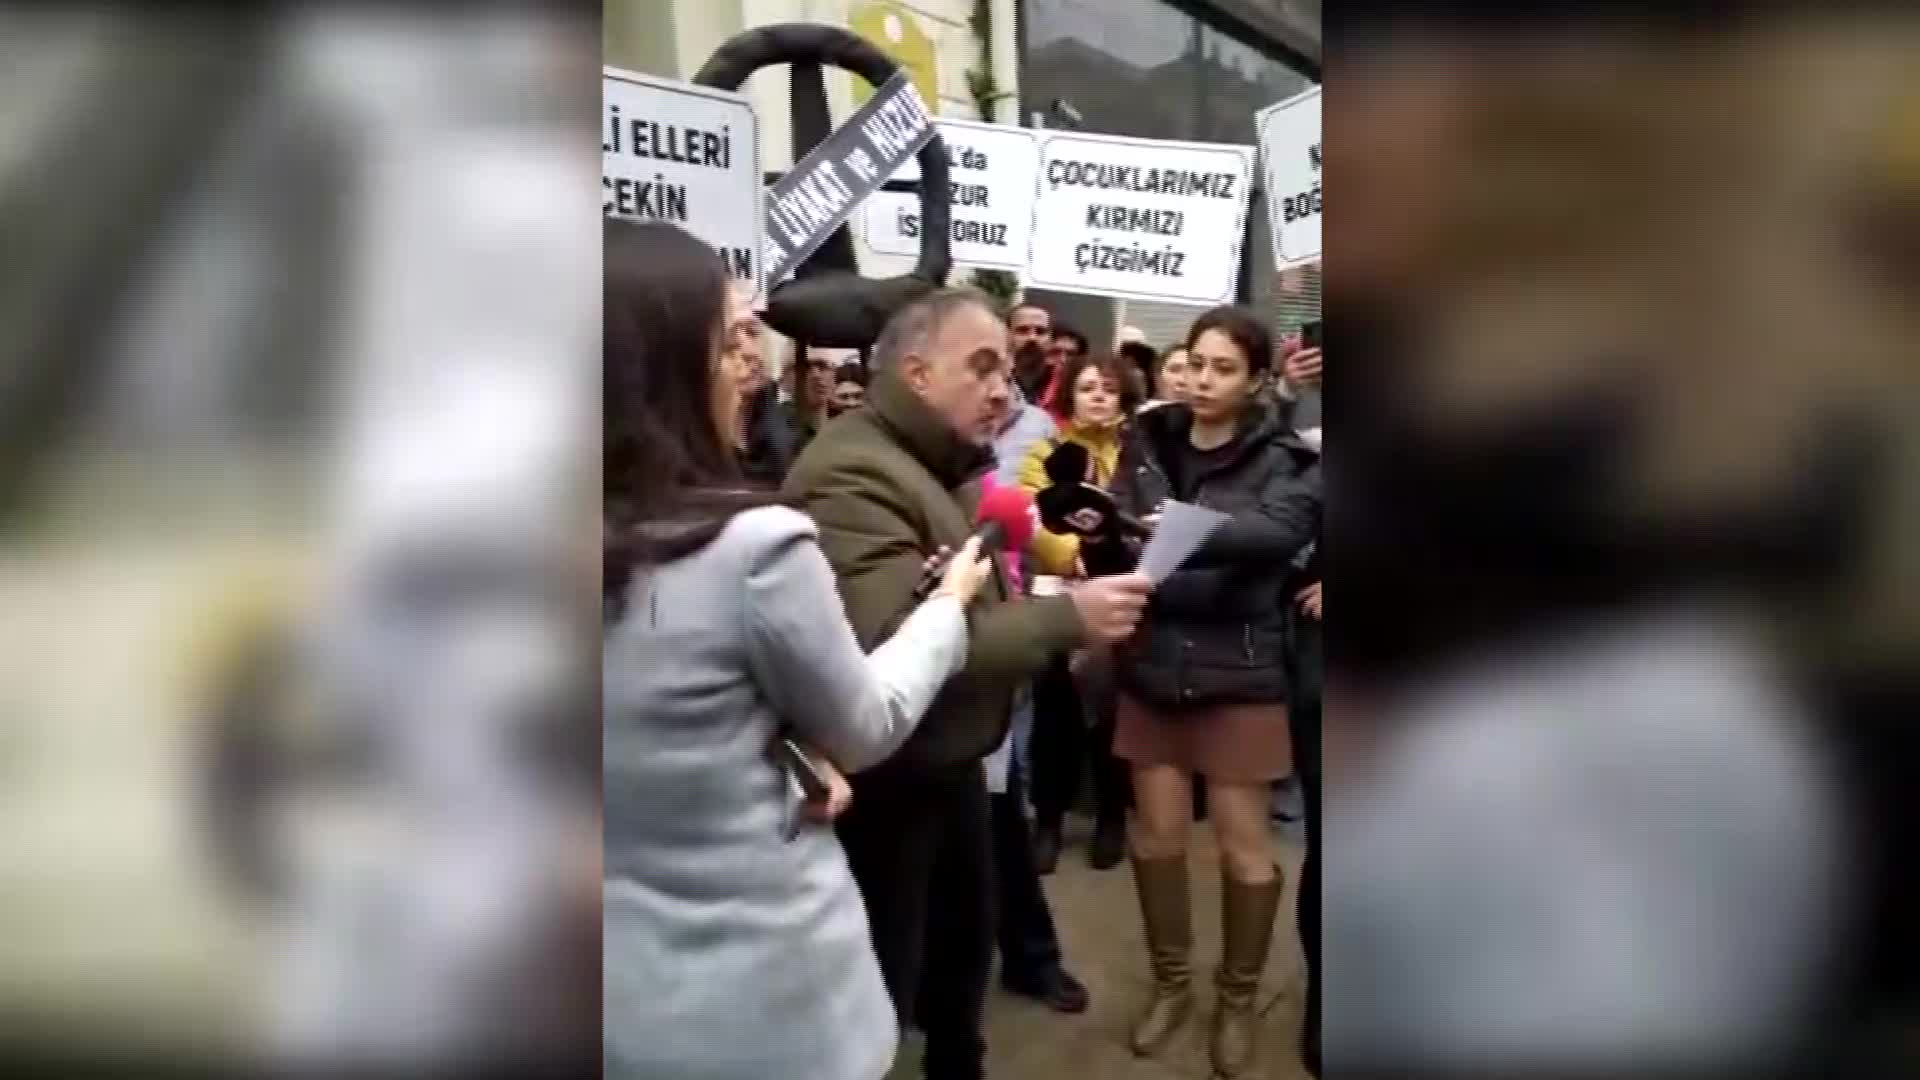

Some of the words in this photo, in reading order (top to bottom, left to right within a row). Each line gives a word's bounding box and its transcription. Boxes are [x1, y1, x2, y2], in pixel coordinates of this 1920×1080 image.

[632, 118, 729, 168] ELLERİ
[944, 144, 988, 170] L'da
[769, 159, 854, 246] LİYAKAT
[843, 147, 880, 182] ve
[947, 182, 989, 207] ZUR
[1048, 159, 1237, 199] ÇOCUKLARIMIZ
[897, 206, 1008, 247] İSORUZ
[1086, 204, 1184, 237] KIRMIZI
[1075, 237, 1186, 277] ÇİZGİMİZ
